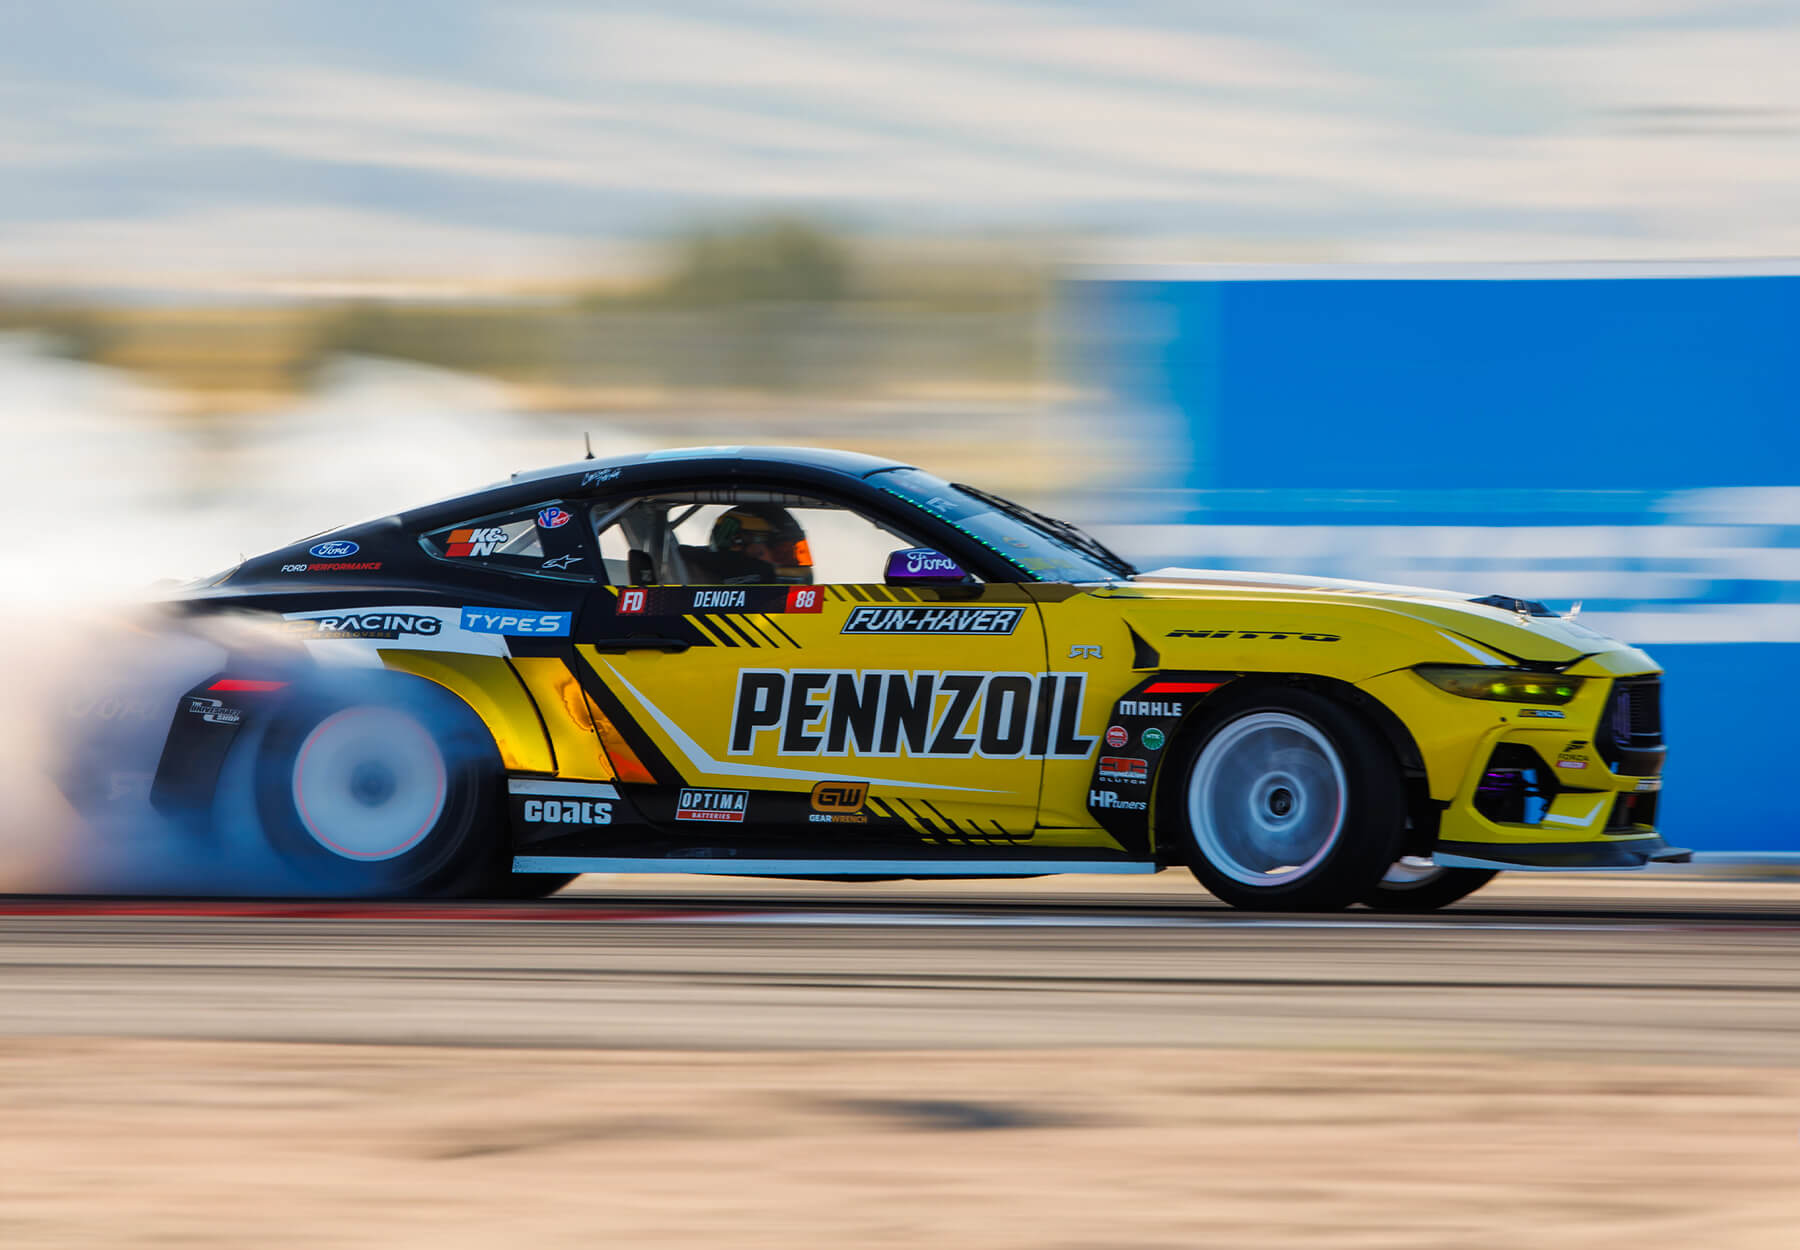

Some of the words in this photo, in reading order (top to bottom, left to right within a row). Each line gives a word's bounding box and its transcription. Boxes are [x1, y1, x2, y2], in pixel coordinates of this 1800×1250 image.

[318, 543, 351, 556] Ford
[281, 563, 307, 573] FORD
[308, 561, 383, 572] PERFORMANCE
[622, 591, 645, 612] FD
[693, 591, 746, 608] DENOFA
[795, 591, 816, 608] 88
[318, 615, 437, 633] RACING
[848, 609, 1017, 632] FUN-HAVER
[1165, 629, 1341, 642] NITTO
[728, 669, 1100, 759] PENNZOIL
[1119, 701, 1182, 717] MAHLE
[682, 792, 744, 810] OPTIMA
[691, 812, 731, 820] BATTERIES
